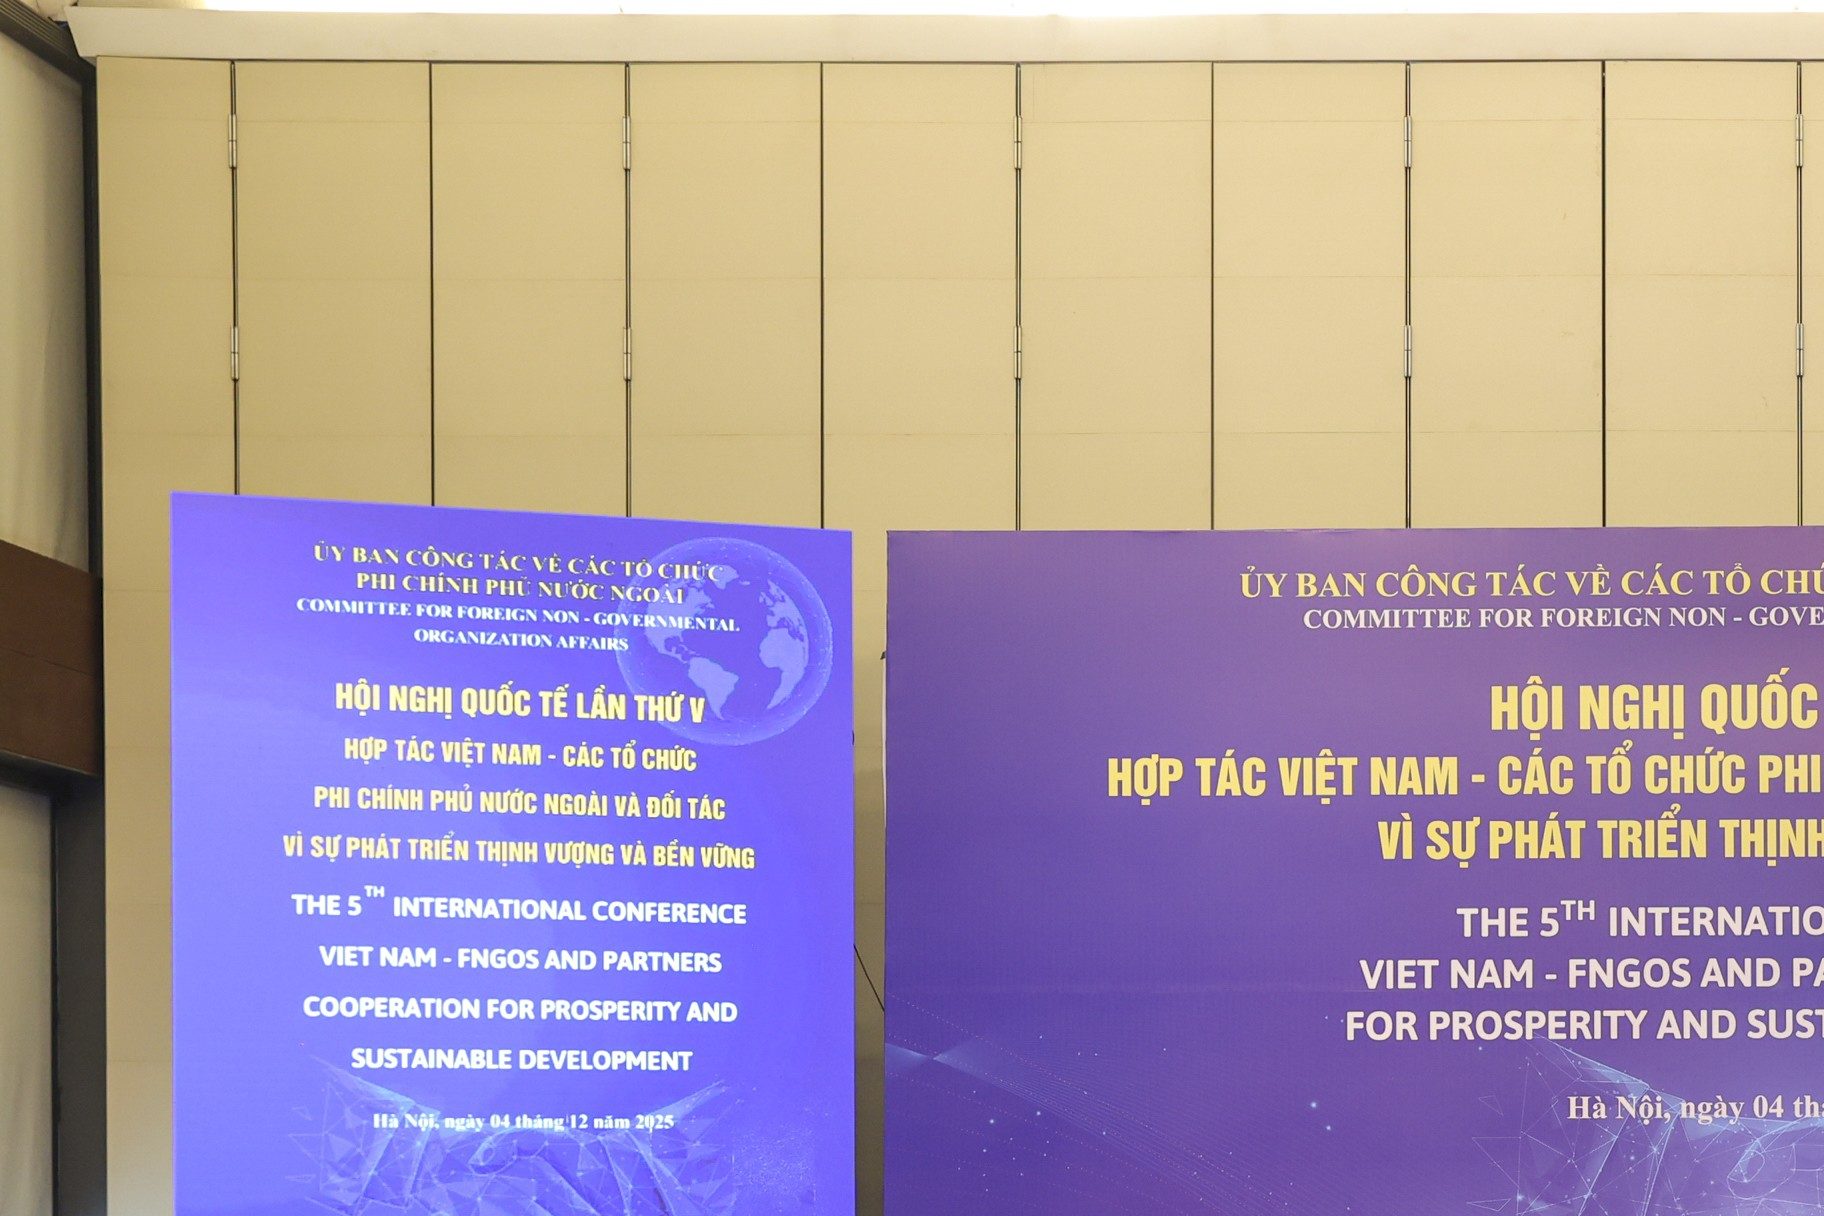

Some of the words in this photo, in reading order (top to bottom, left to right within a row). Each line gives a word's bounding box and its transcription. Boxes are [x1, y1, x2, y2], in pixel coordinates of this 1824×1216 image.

[1240, 566, 1287, 597] ỦY
[1296, 573, 1366, 597] BAN
[1376, 564, 1476, 597] CÔNG
[1486, 564, 1555, 596] TÁC
[1565, 564, 1611, 595] VỀ
[1622, 563, 1693, 595] CÁC
[1703, 563, 1750, 594] TỔ
[297, 598, 411, 615] COMMITTEE
[417, 604, 452, 618] FOR
[458, 606, 537, 621] FOREIGN
[543, 610, 579, 623] NON
[593, 612, 740, 632] GOVERNMENTAL
[1304, 609, 1471, 628] COMMITTEE
[1479, 609, 1533, 627] FOR
[1541, 608, 1661, 627] FOREIGN
[1669, 607, 1726, 626] NON
[1492, 676, 1563, 740] HỘI
[1580, 685, 1684, 741] NGHỊ
[1701, 666, 1817, 734] QUỐC
[1109, 754, 1183, 805] HỢP
[1195, 749, 1265, 796] TÁC
[1278, 749, 1358, 804] VIỆT
[1371, 757, 1457, 795] NAM
[1499, 748, 1573, 795] CÁC
[1586, 739, 1633, 794] TỔ
[1645, 747, 1745, 794] CHỨC
[1759, 755, 1820, 793] PHI
[1378, 813, 1412, 859] VÌ
[1426, 817, 1480, 868] SỰ
[1490, 812, 1585, 859] PHÁT
[1597, 805, 1706, 858] TRIỂN
[291, 894, 340, 915] THE
[394, 897, 586, 920] INTERNATIONAL
[593, 901, 746, 924] CONFERENCE
[1457, 908, 1528, 937] THE
[319, 946, 373, 966] VIET
[380, 947, 436, 967] NAM
[458, 948, 539, 969] FNGOS
[544, 950, 596, 970] AND
[604, 951, 722, 972] PARTNERS
[1360, 960, 1439, 989] VIET
[1451, 959, 1532, 988] NAM
[1569, 958, 1691, 988] FNGOS
[1701, 958, 1780, 987] AND
[304, 996, 480, 1018] COOPERATION
[487, 999, 534, 1019] FOR
[541, 1000, 681, 1021] PROSPERITY
[687, 1002, 737, 1022] AND
[1347, 1011, 1418, 1040] FOR
[1430, 1010, 1648, 1040] PROSPERITY
[1657, 1010, 1736, 1039] AND
[352, 1048, 512, 1069] SUSTAINABLE
[519, 1050, 693, 1070] DEVELOPMENT
[374, 1114, 399, 1128] Hà
[405, 1113, 440, 1132] Nội,
[444, 1114, 483, 1132] ngày
[490, 1114, 510, 1128] 04
[515, 1113, 565, 1133] tháng
[570, 1114, 588, 1130] 12
[594, 1114, 630, 1130] năm
[636, 1114, 674, 1130] 2025
[1567, 1095, 1608, 1120] Hà
[1616, 1094, 1672, 1125] Nội,
[1680, 1095, 1744, 1124] ngày
[1753, 1095, 1784, 1119] 04
